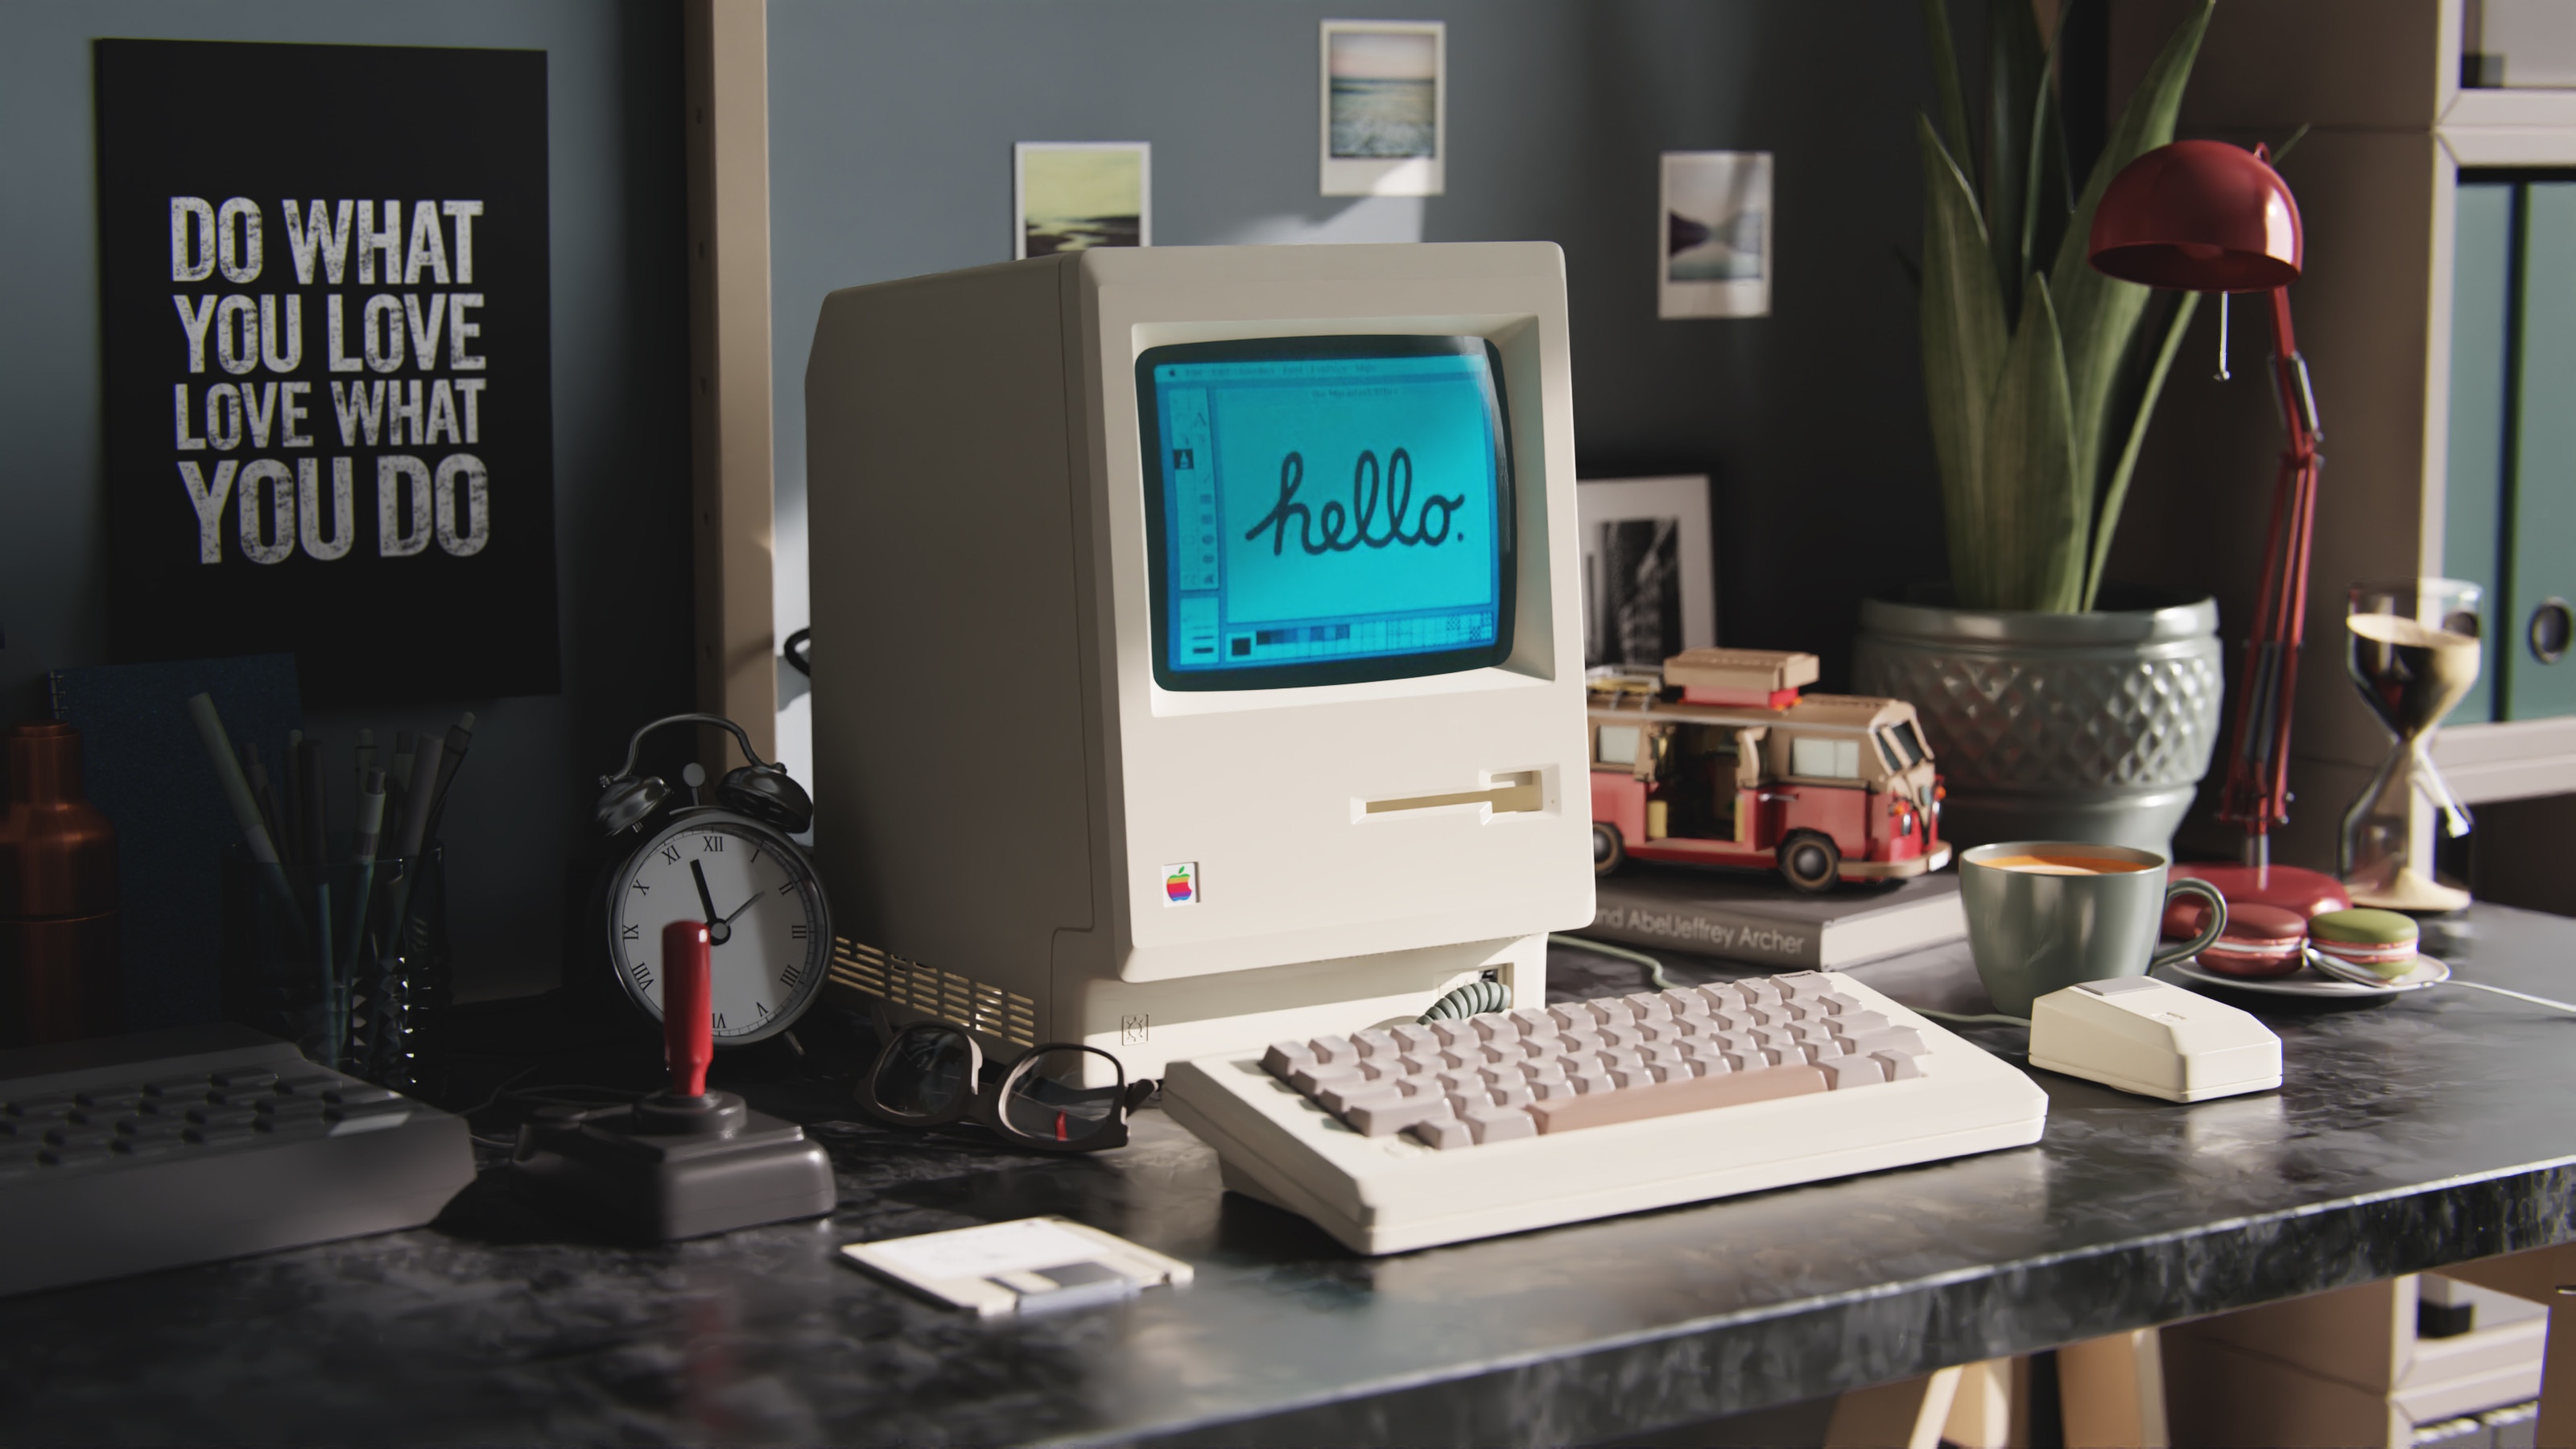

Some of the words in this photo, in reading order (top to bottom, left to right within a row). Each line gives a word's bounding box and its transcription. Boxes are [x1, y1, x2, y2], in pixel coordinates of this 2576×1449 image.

[171, 196, 263, 285] DO
[282, 199, 484, 285] WHAT
[173, 294, 303, 375] YOU
[328, 293, 486, 374] LOVE
[175, 382, 313, 451] LOVE
[330, 378, 487, 447] WHAT
[177, 455, 354, 564] YOU
[378, 453, 489, 558] DO
[1245, 448, 1465, 555] hello.
[661, 844, 681, 865] XI
[703, 836, 724, 852] XII
[632, 879, 650, 896] X
[778, 881, 795, 896] II
[622, 924, 639, 940] IX
[791, 925, 807, 940] III
[1737, 926, 1806, 956] Archer
[632, 962, 654, 991] VIII
[756, 1001, 769, 1018] V
